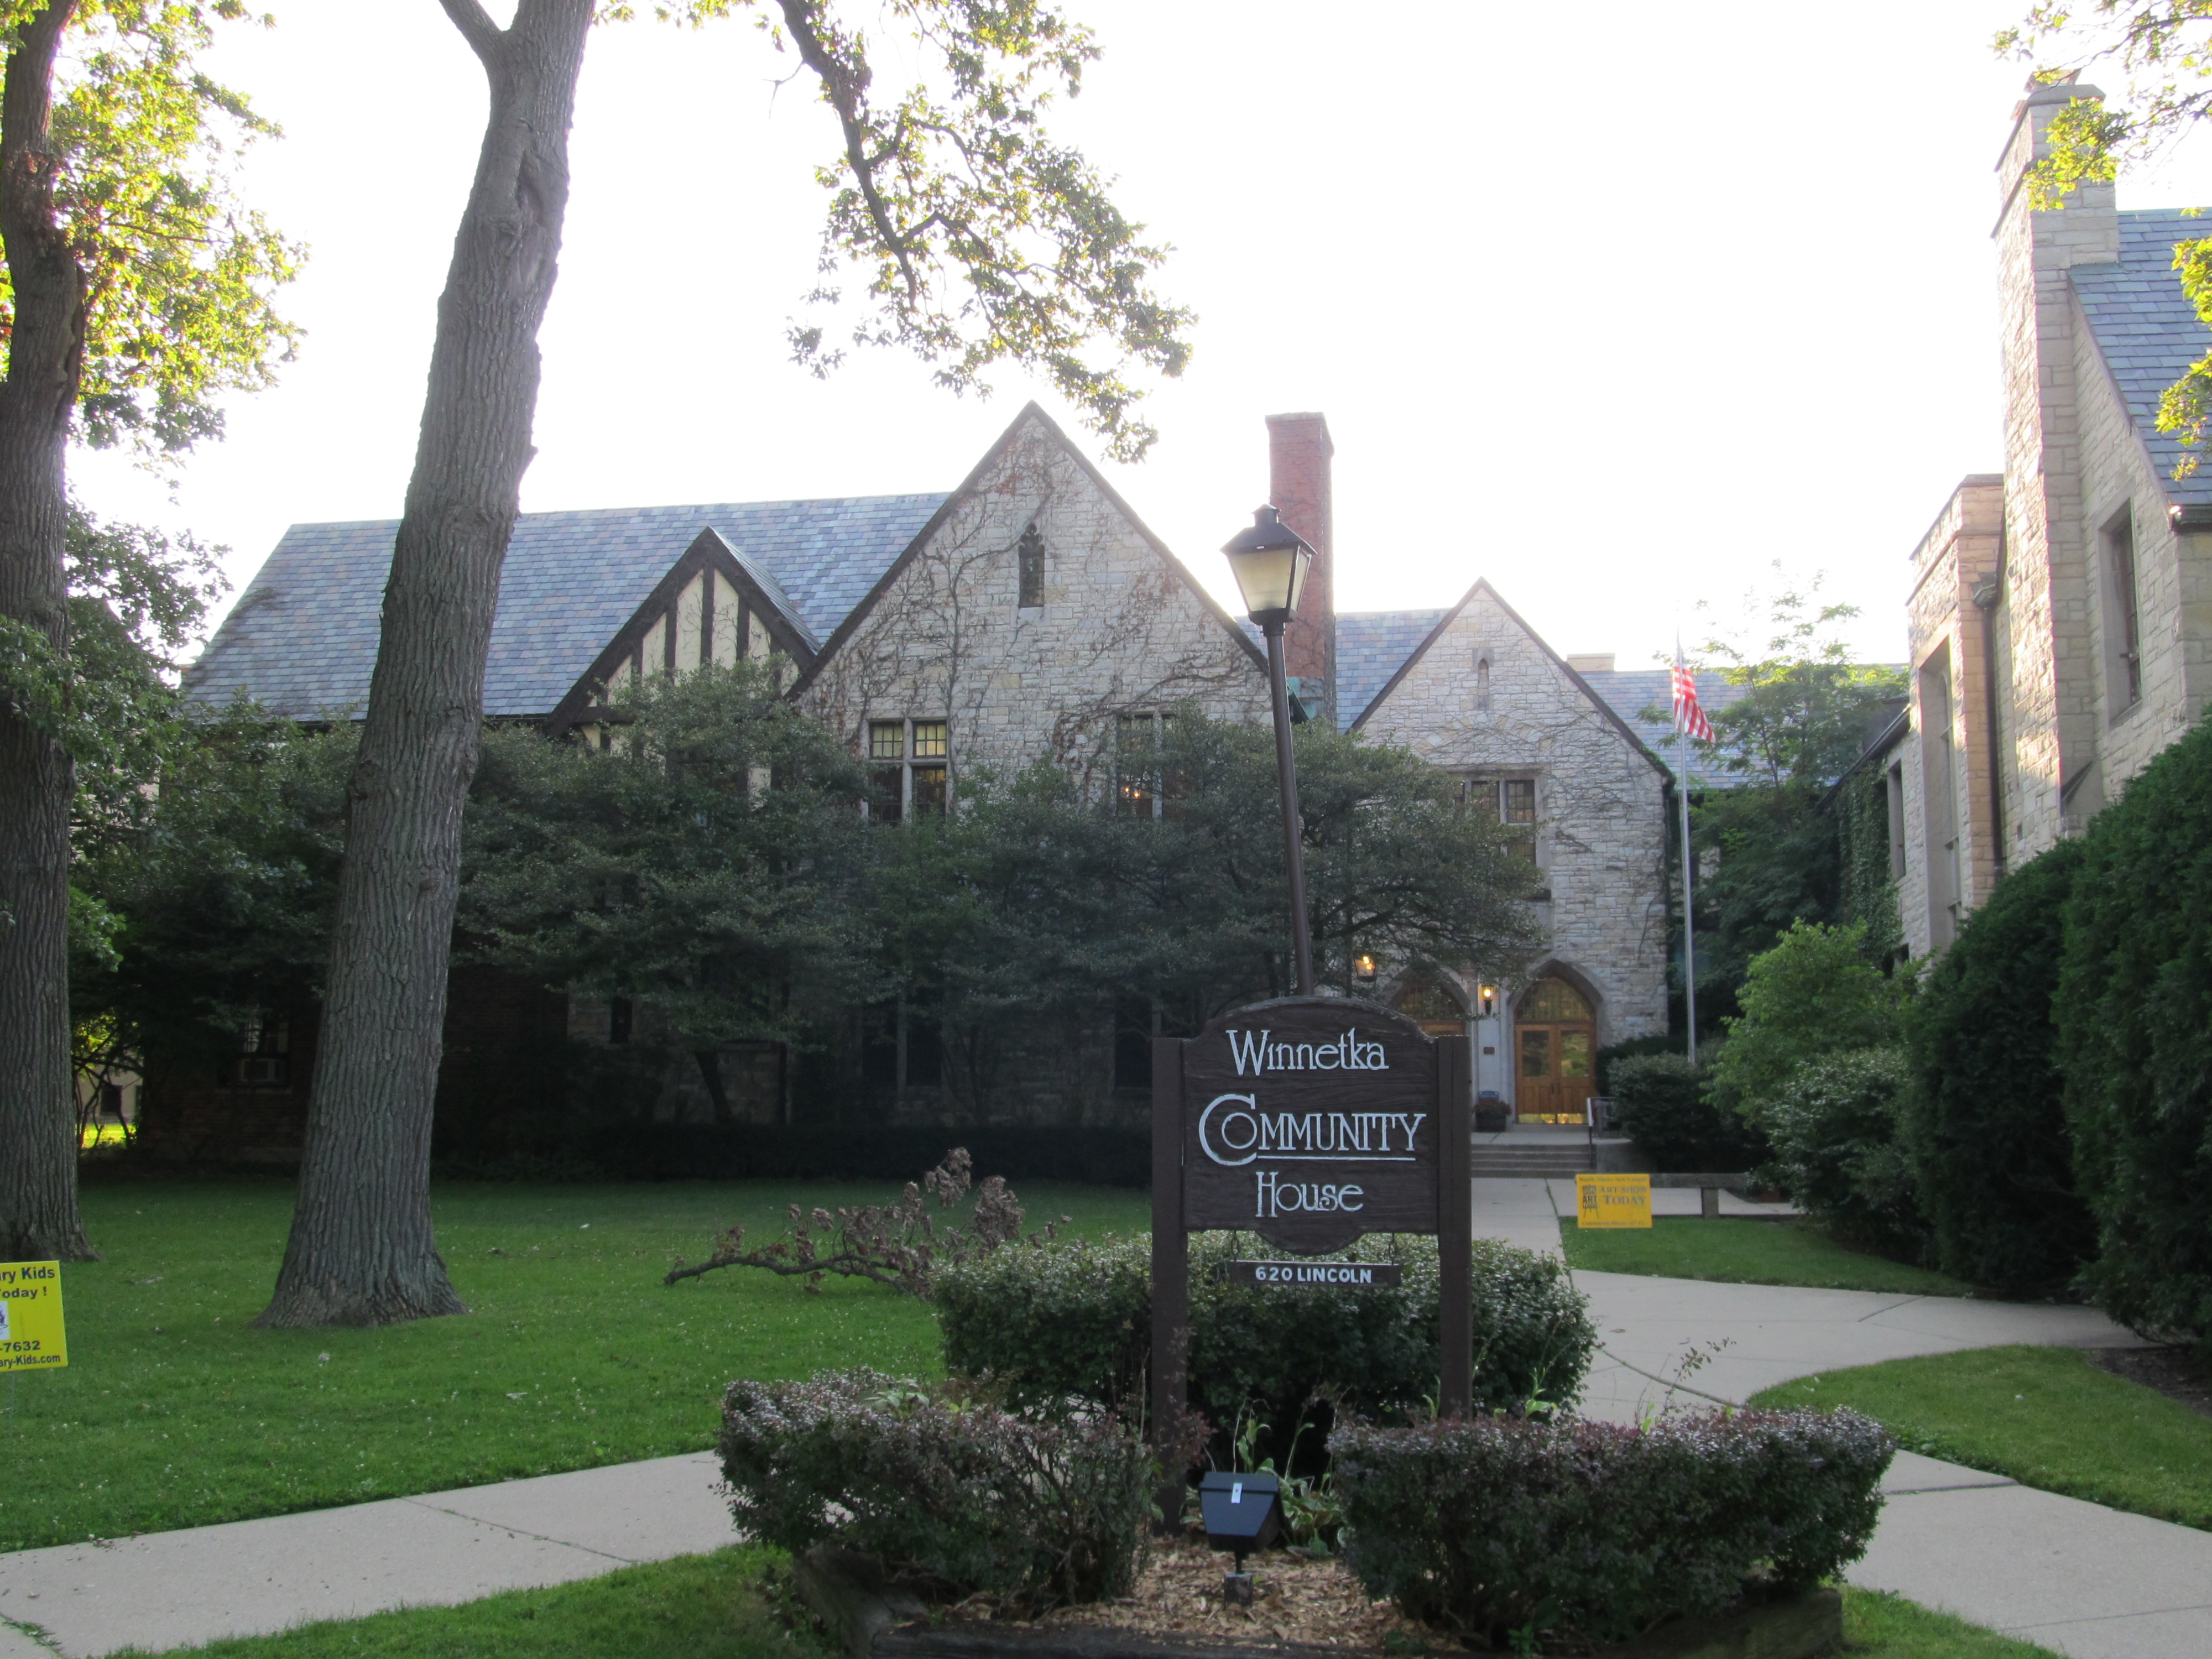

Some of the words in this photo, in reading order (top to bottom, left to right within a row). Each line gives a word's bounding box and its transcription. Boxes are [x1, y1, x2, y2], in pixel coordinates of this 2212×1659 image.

[1225, 1027, 1390, 1076] Winnetka
[1198, 1093, 1427, 1167] COMMUNITY
[1255, 1171, 1364, 1218] House
[1603, 1195, 1646, 1205] TODAY
[0, 1271, 16, 1284] ry
[22, 1266, 55, 1280] Kids
[1255, 1266, 1293, 1282] 620
[1296, 1267, 1372, 1285] LINCOLN
[0, 1287, 38, 1300] oday
